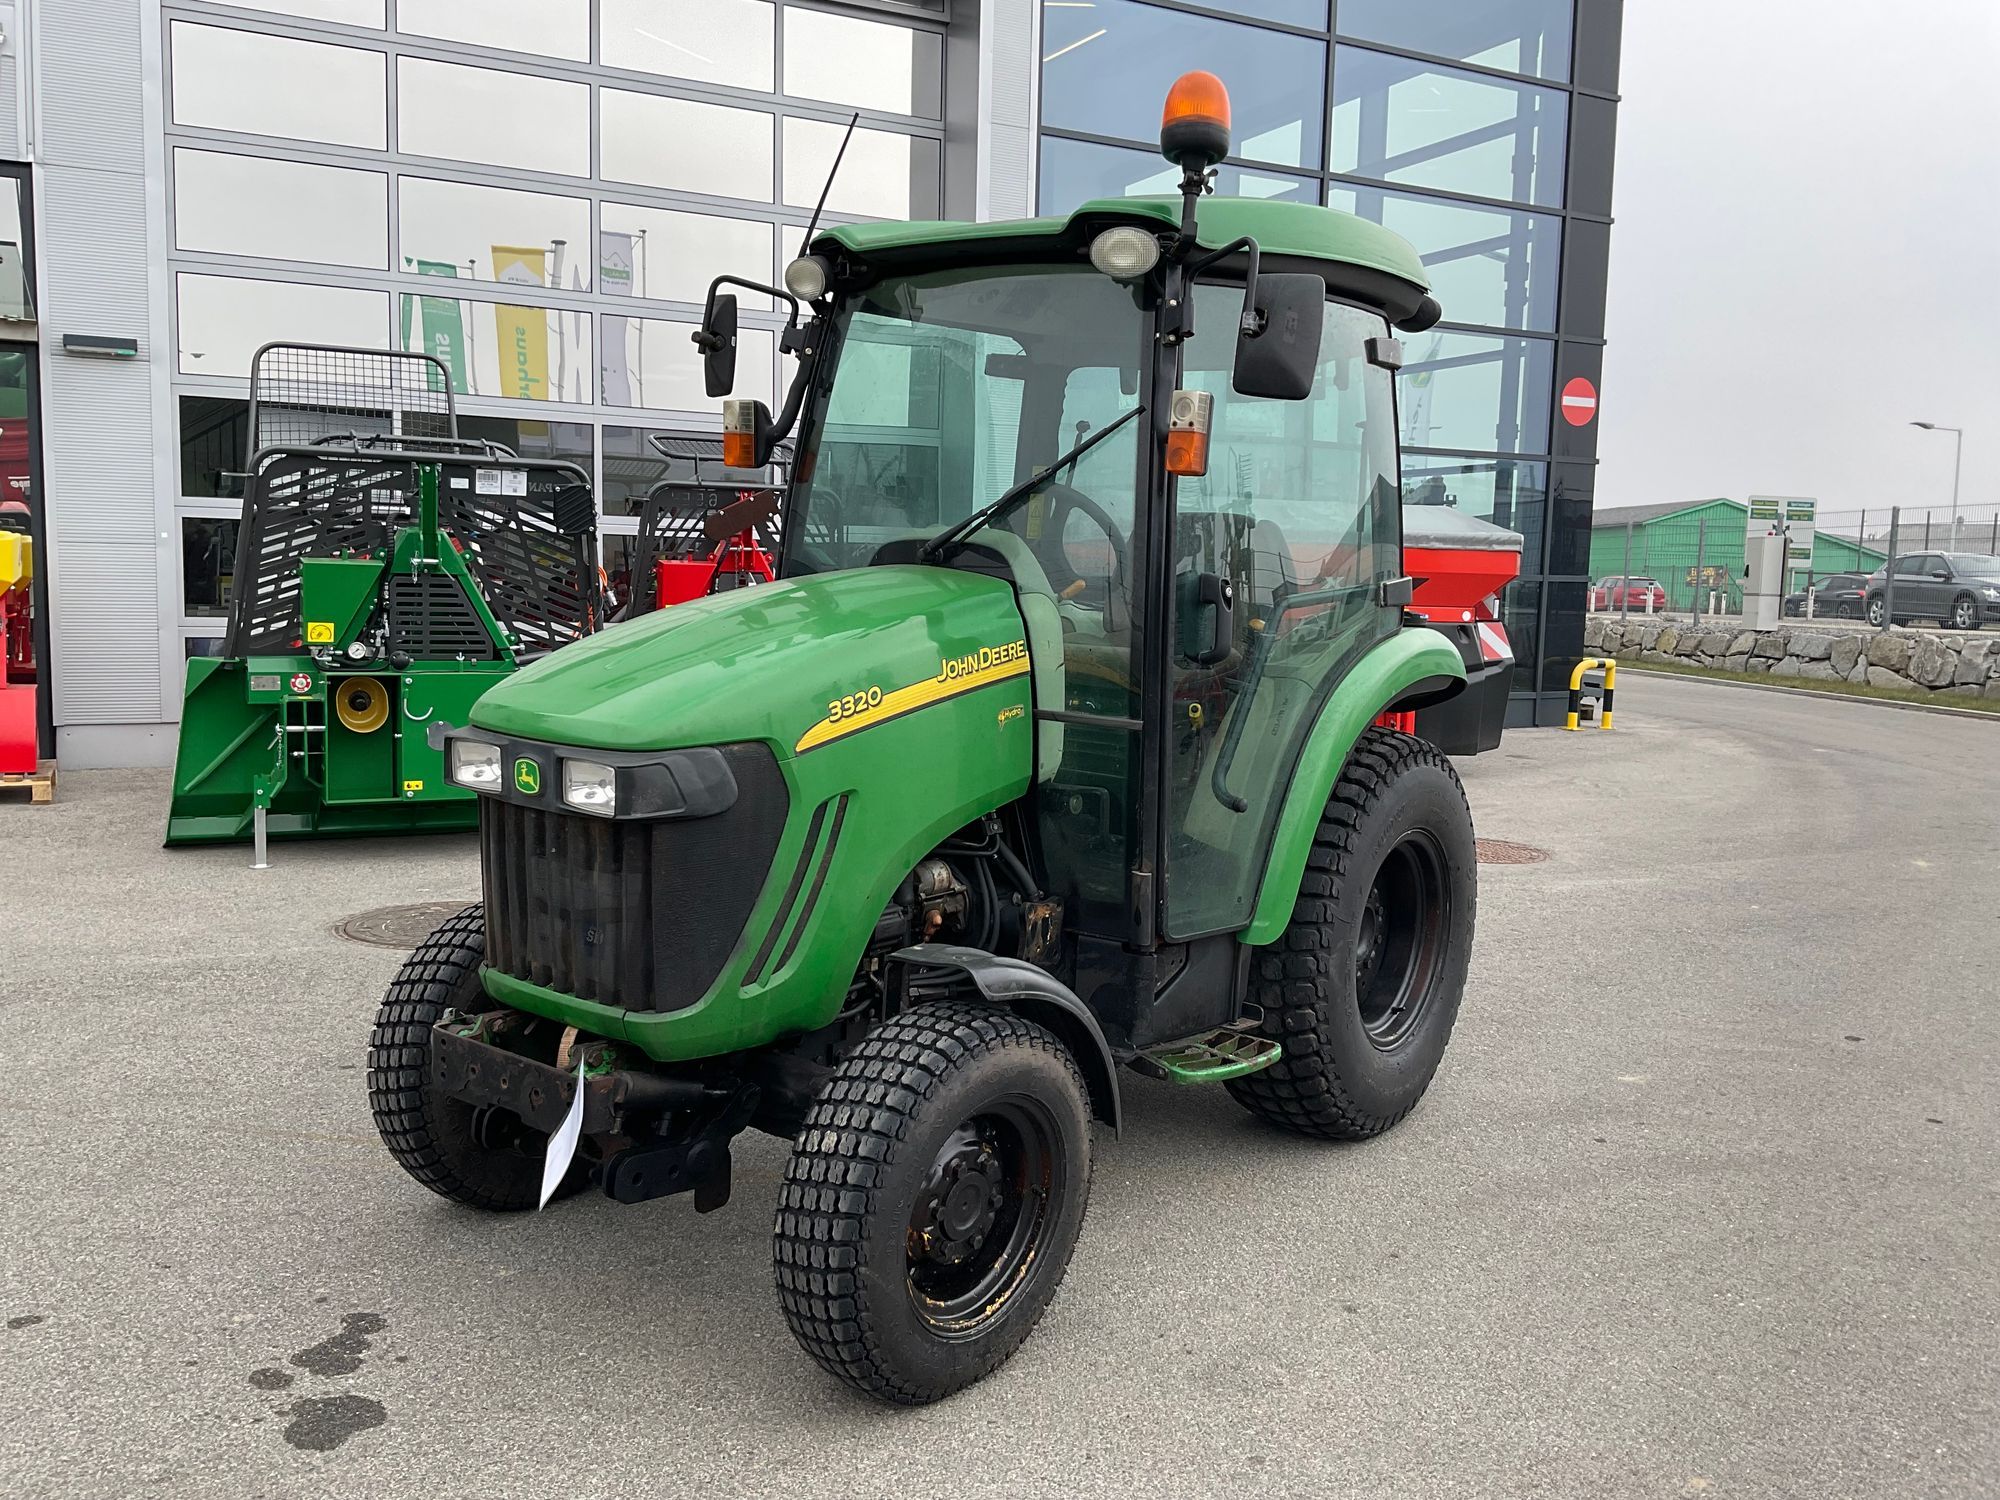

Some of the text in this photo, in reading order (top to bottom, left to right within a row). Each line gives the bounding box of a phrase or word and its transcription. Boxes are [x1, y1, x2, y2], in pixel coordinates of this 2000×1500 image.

[936, 639, 1026, 683] JOHN DEERE
[827, 685, 883, 724] 3320
